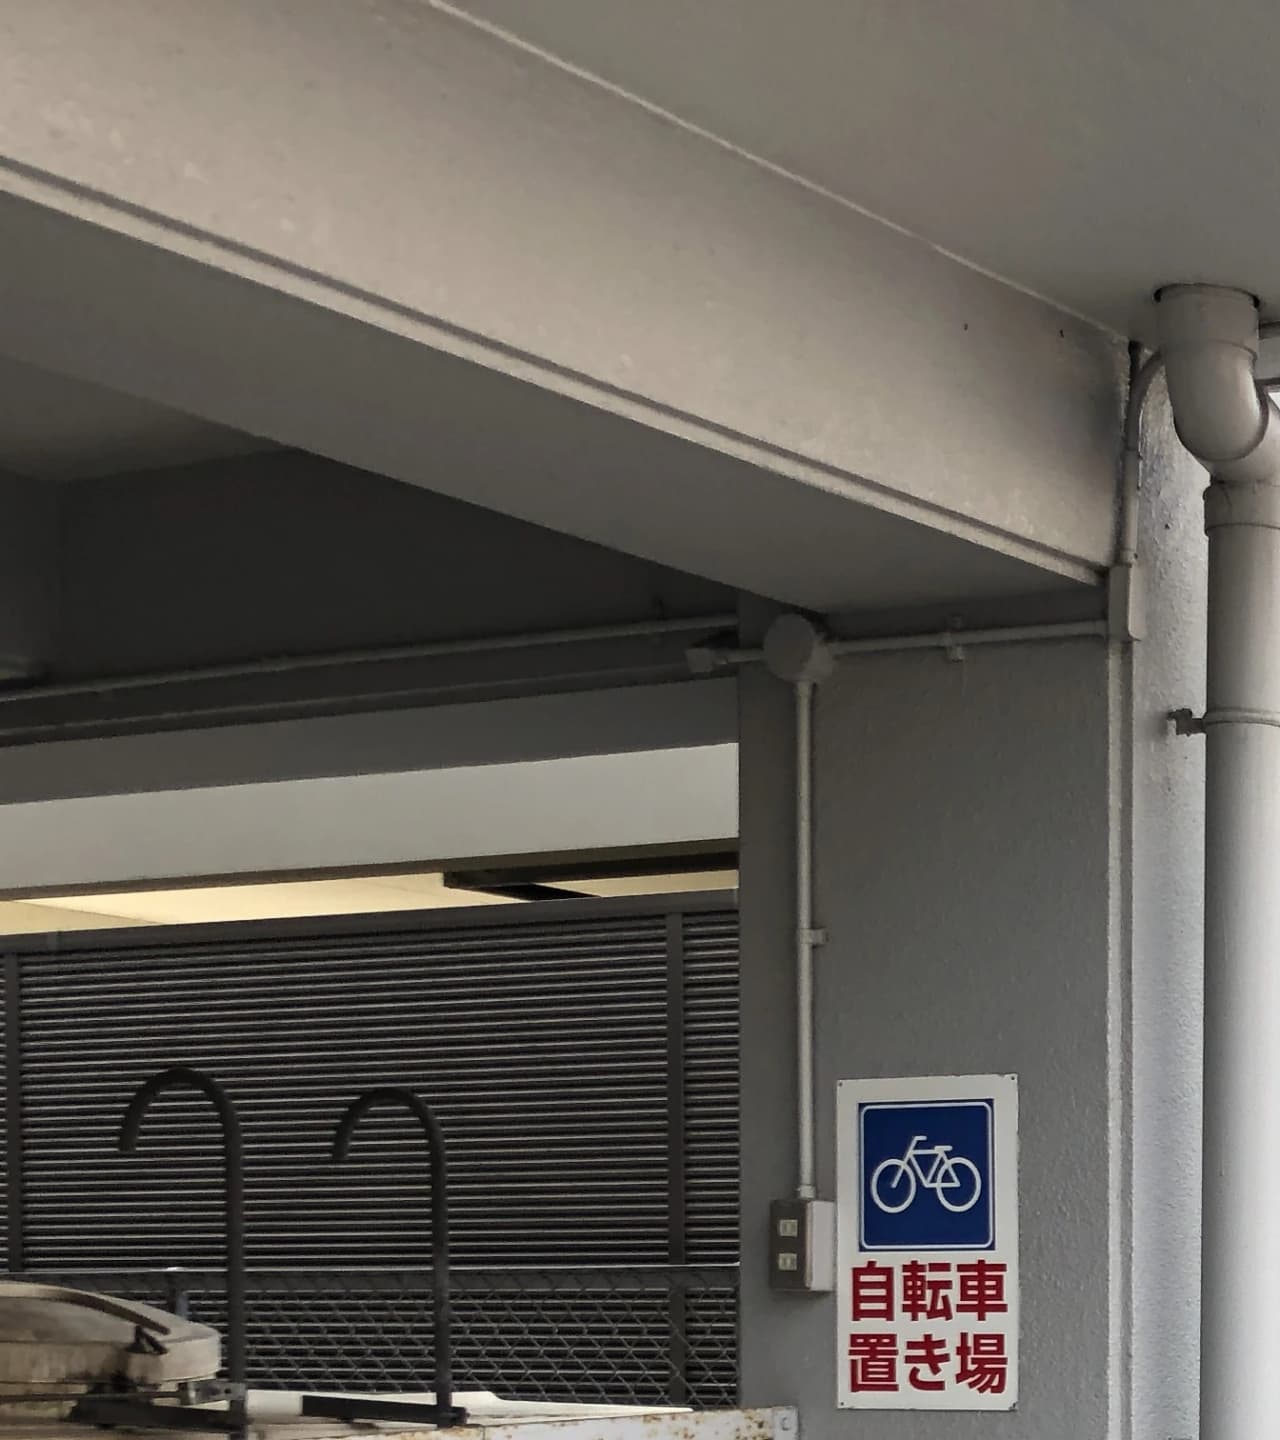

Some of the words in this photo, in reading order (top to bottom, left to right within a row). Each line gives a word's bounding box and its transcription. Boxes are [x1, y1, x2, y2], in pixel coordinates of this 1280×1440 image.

[852, 1259, 1008, 1322] 自転車
[848, 1332, 1008, 1394] 置き場
